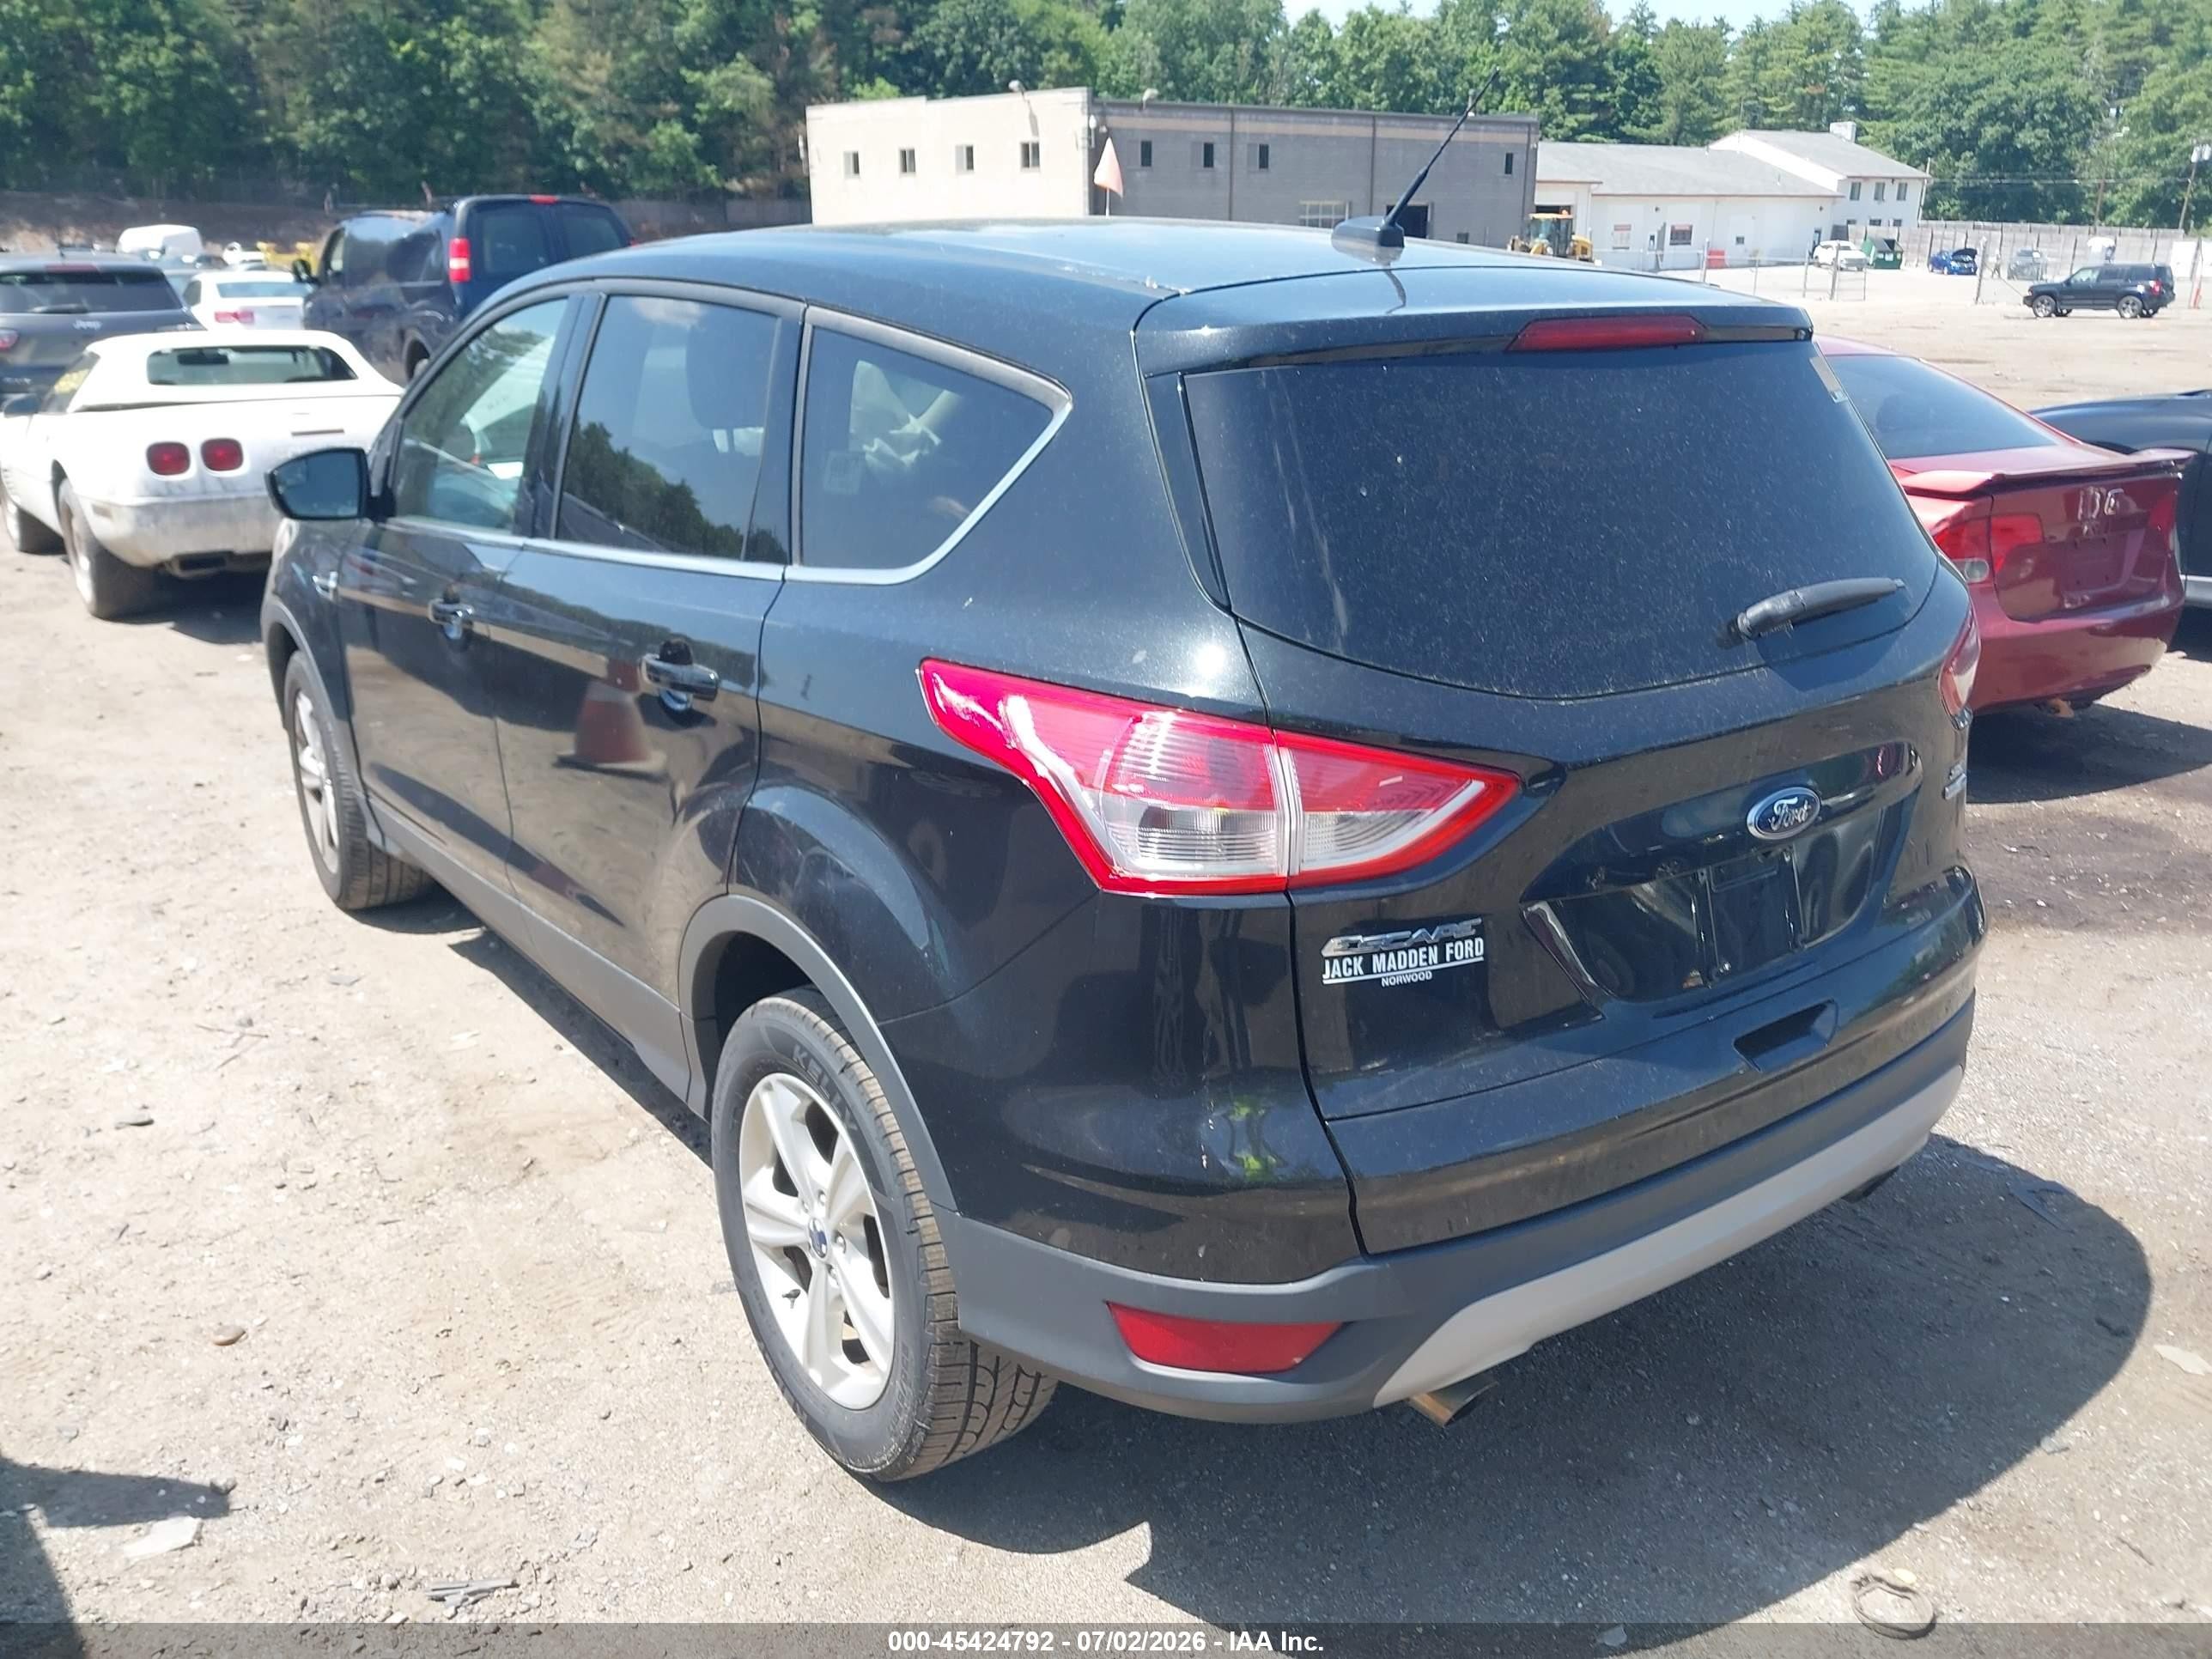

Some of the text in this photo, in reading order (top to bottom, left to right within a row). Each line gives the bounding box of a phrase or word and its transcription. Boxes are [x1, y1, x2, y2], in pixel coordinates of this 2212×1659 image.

[1321, 917, 1482, 957] ESCAPE
[1322, 938, 1484, 979] JACK MADDEN FORD
[1382, 970, 1433, 988] NORWOOD
[792, 1044, 859, 1132] KELLY
